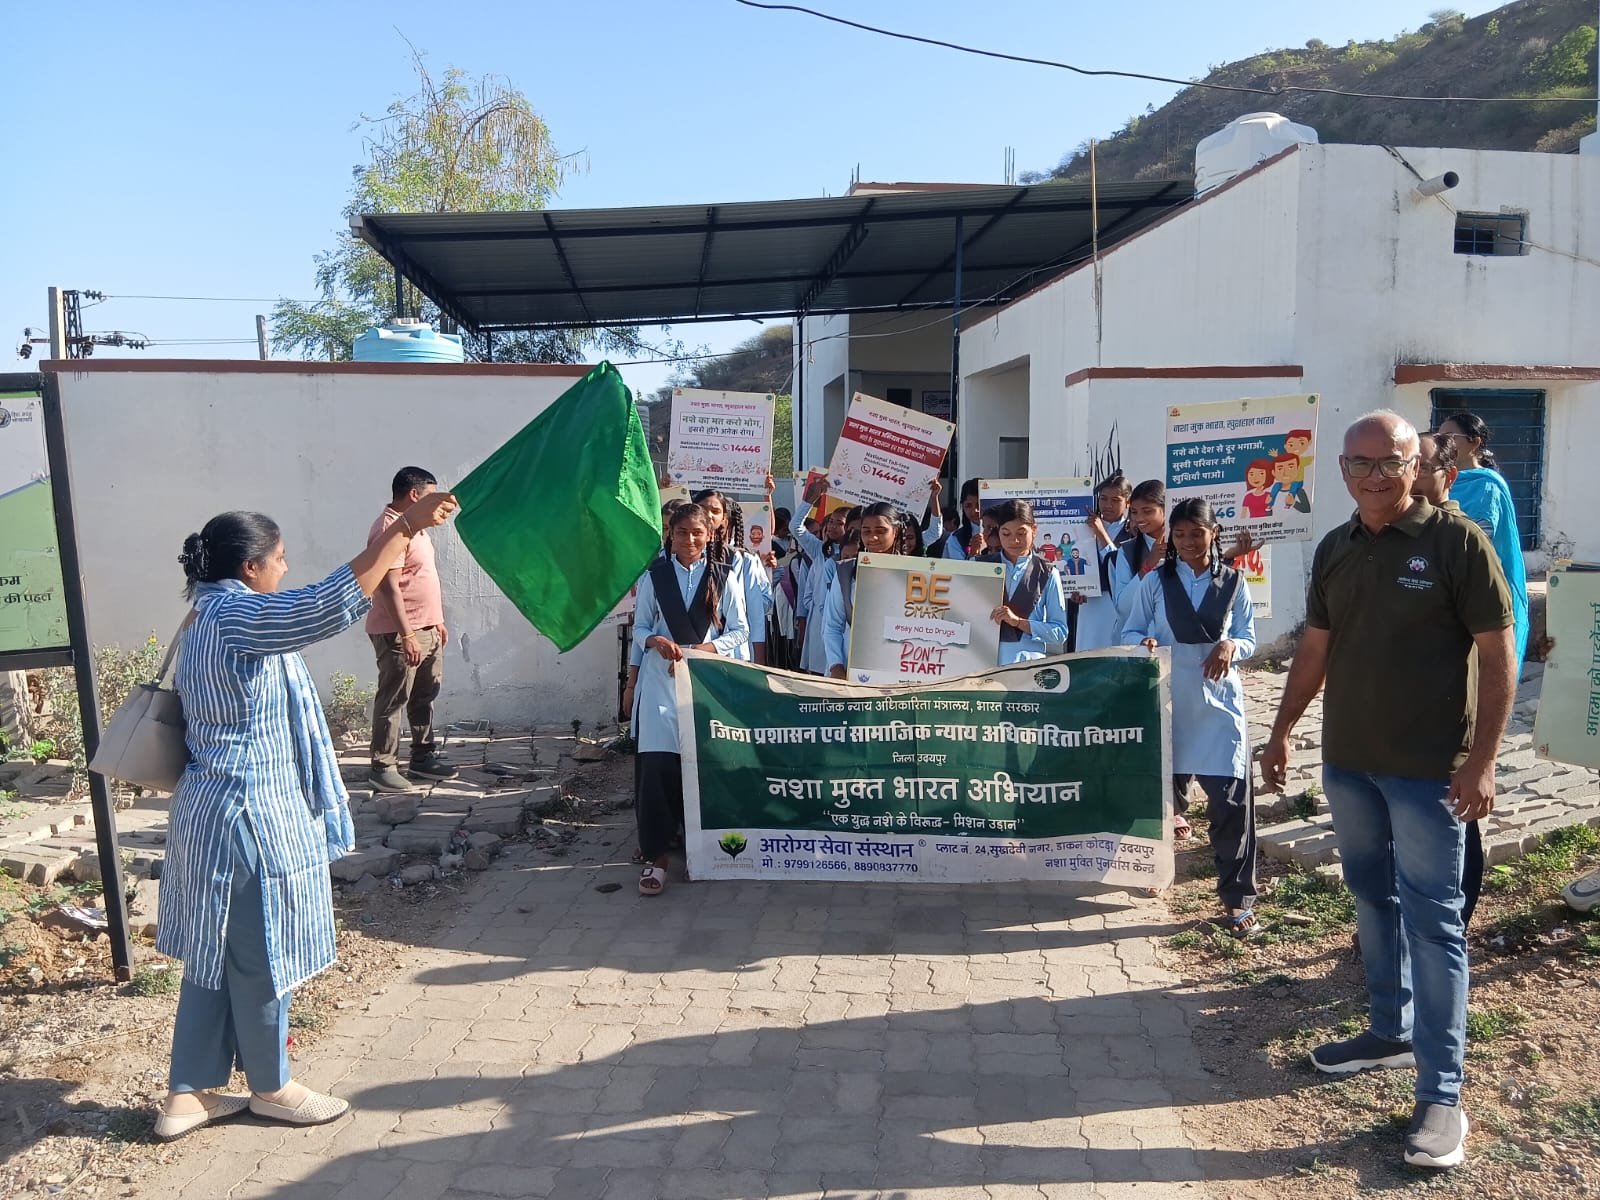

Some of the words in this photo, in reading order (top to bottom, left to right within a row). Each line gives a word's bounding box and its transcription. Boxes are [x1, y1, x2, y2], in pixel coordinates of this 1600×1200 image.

[698, 416, 709, 424] का
[711, 417, 724, 425] मत
[725, 417, 742, 426] करो
[1256, 416, 1275, 425] भारत
[731, 444, 761, 453] 14446
[1172, 447, 1186, 457] नशे
[1187, 445, 1200, 455] को
[1201, 444, 1214, 454] देश
[1215, 443, 1224, 452] से
[1225, 443, 1236, 455] दूर
[1237, 440, 1265, 450] भगाओ,
[1172, 459, 1191, 471] सुखी
[1193, 458, 1219, 468] परिवार
[1220, 456, 1236, 466] और
[872, 467, 906, 485] 14446
[1205, 492, 1236, 501] Toll-free
[905, 571, 952, 606] BE
[4, 592, 21, 604] की
[935, 627, 956, 638] Drugs
[900, 641, 949, 663] DON'T
[900, 661, 945, 675] START
[799, 699, 844, 713] सामाजिक
[848, 700, 872, 713] न्याय
[876, 697, 931, 712] अधिकारिता
[933, 697, 973, 713] मंत्रालय,
[976, 701, 1003, 712] भारत
[1006, 702, 1040, 713] सरकार
[710, 719, 751, 743] जिला
[754, 726, 816, 744] प्रशासन
[820, 721, 848, 743] एवं
[850, 720, 931, 743] सामाजिक
[935, 724, 978, 741] न्याय
[982, 721, 1081, 748] अधिकारिता
[1084, 725, 1144, 744] विभाग
[892, 752, 915, 764] जिला
[917, 753, 947, 767] उदयपुर
[766, 776, 823, 800] नशा
[830, 777, 885, 808] मुक्त
[893, 777, 959, 801] भारत
[967, 771, 1083, 804] अभियान
[851, 813, 870, 830] युद्ध
[872, 811, 893, 827] नशे
[896, 811, 907, 827] के
[953, 812, 986, 829] मिशन
[760, 834, 816, 854] आरोग्य
[819, 835, 853, 856] सेवा
[855, 838, 914, 858] संस्थान
[936, 843, 958, 854] प्लाट
[1056, 841, 1083, 851] डाकन
[1120, 842, 1154, 859] उदयपुर
[854, 861, 919, 873] 8890837770
[1045, 858, 1067, 868] नशा
[1069, 854, 1093, 871] मुक्ति
[1095, 856, 1130, 872] पुनर्वास
[1132, 859, 1155, 874] केन्द्र
